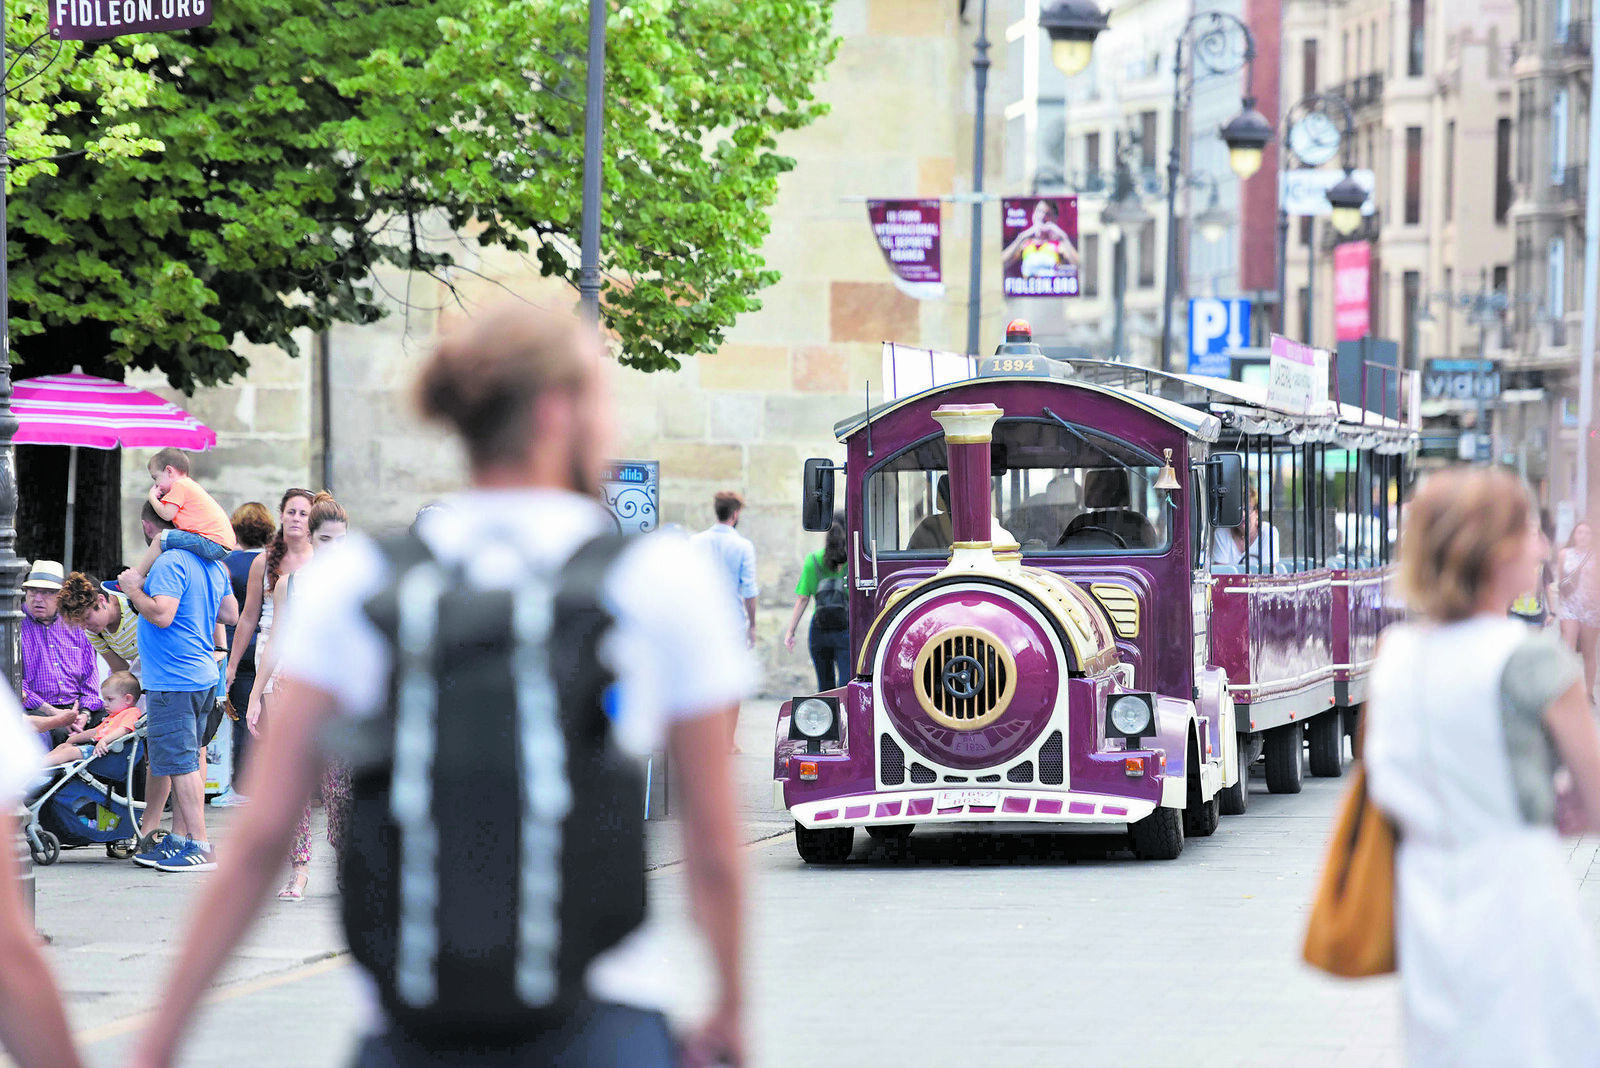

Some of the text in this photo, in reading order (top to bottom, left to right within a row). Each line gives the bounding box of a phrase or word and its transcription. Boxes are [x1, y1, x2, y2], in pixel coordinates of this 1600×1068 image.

[56, 0, 205, 27] FIDLEON.ORG
[1193, 299, 1228, 356] P
[992, 359, 1035, 372] 1894
